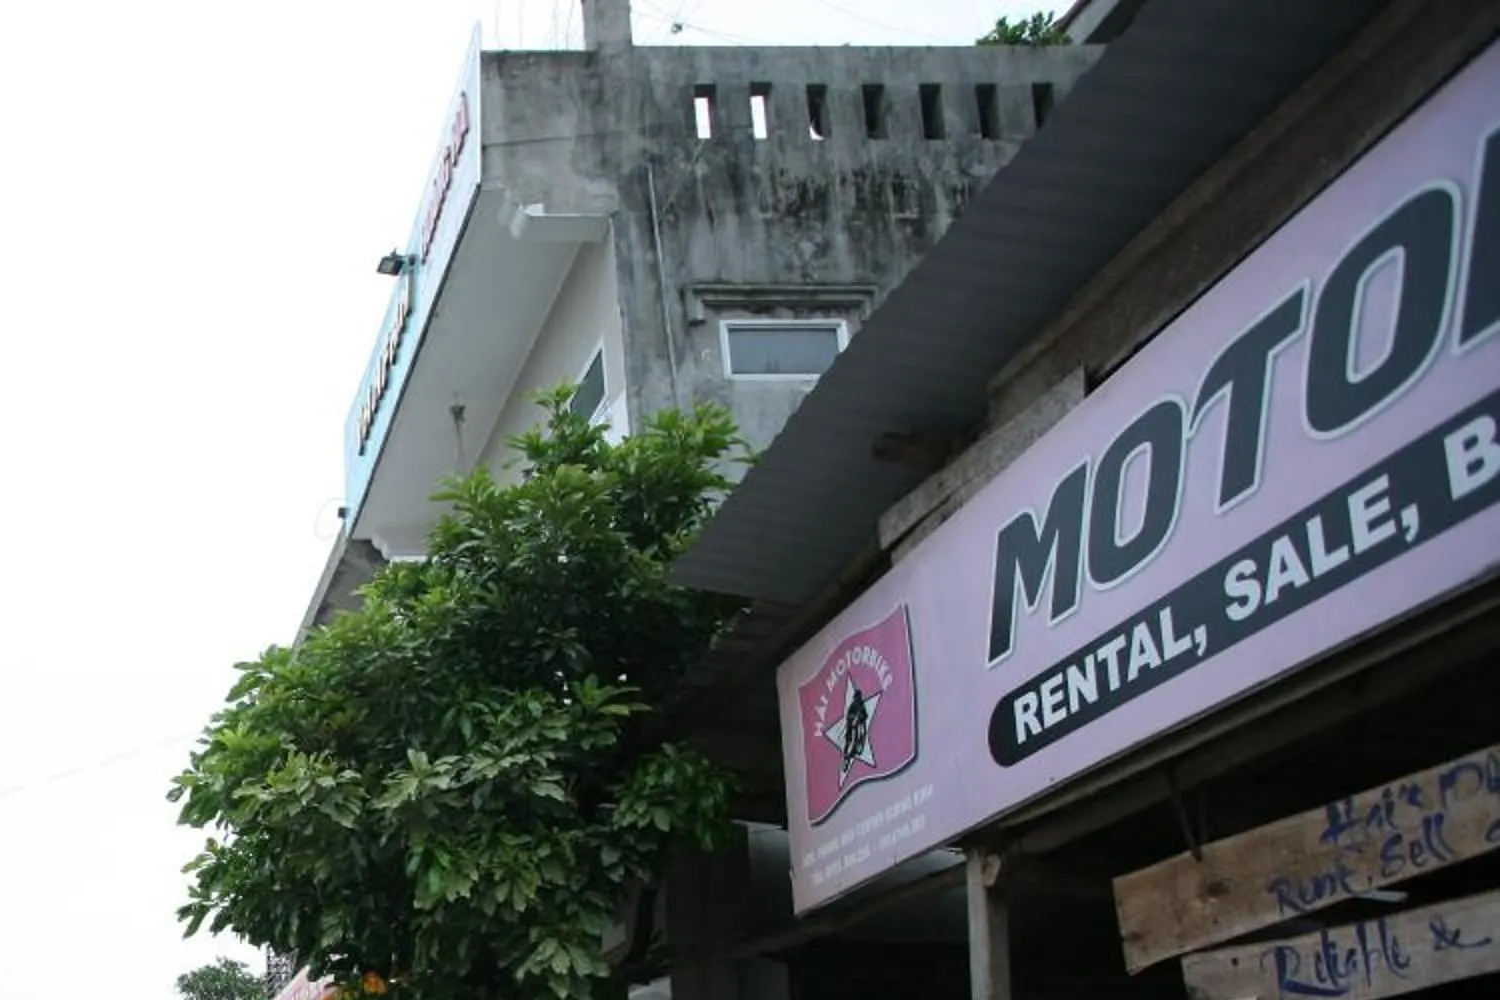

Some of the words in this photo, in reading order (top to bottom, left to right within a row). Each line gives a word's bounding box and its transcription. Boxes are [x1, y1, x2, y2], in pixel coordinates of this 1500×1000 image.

[987, 125, 1500, 669] MOTO
[1011, 606, 1208, 746] RENTAL,
[1224, 474, 1421, 623] SALE,
